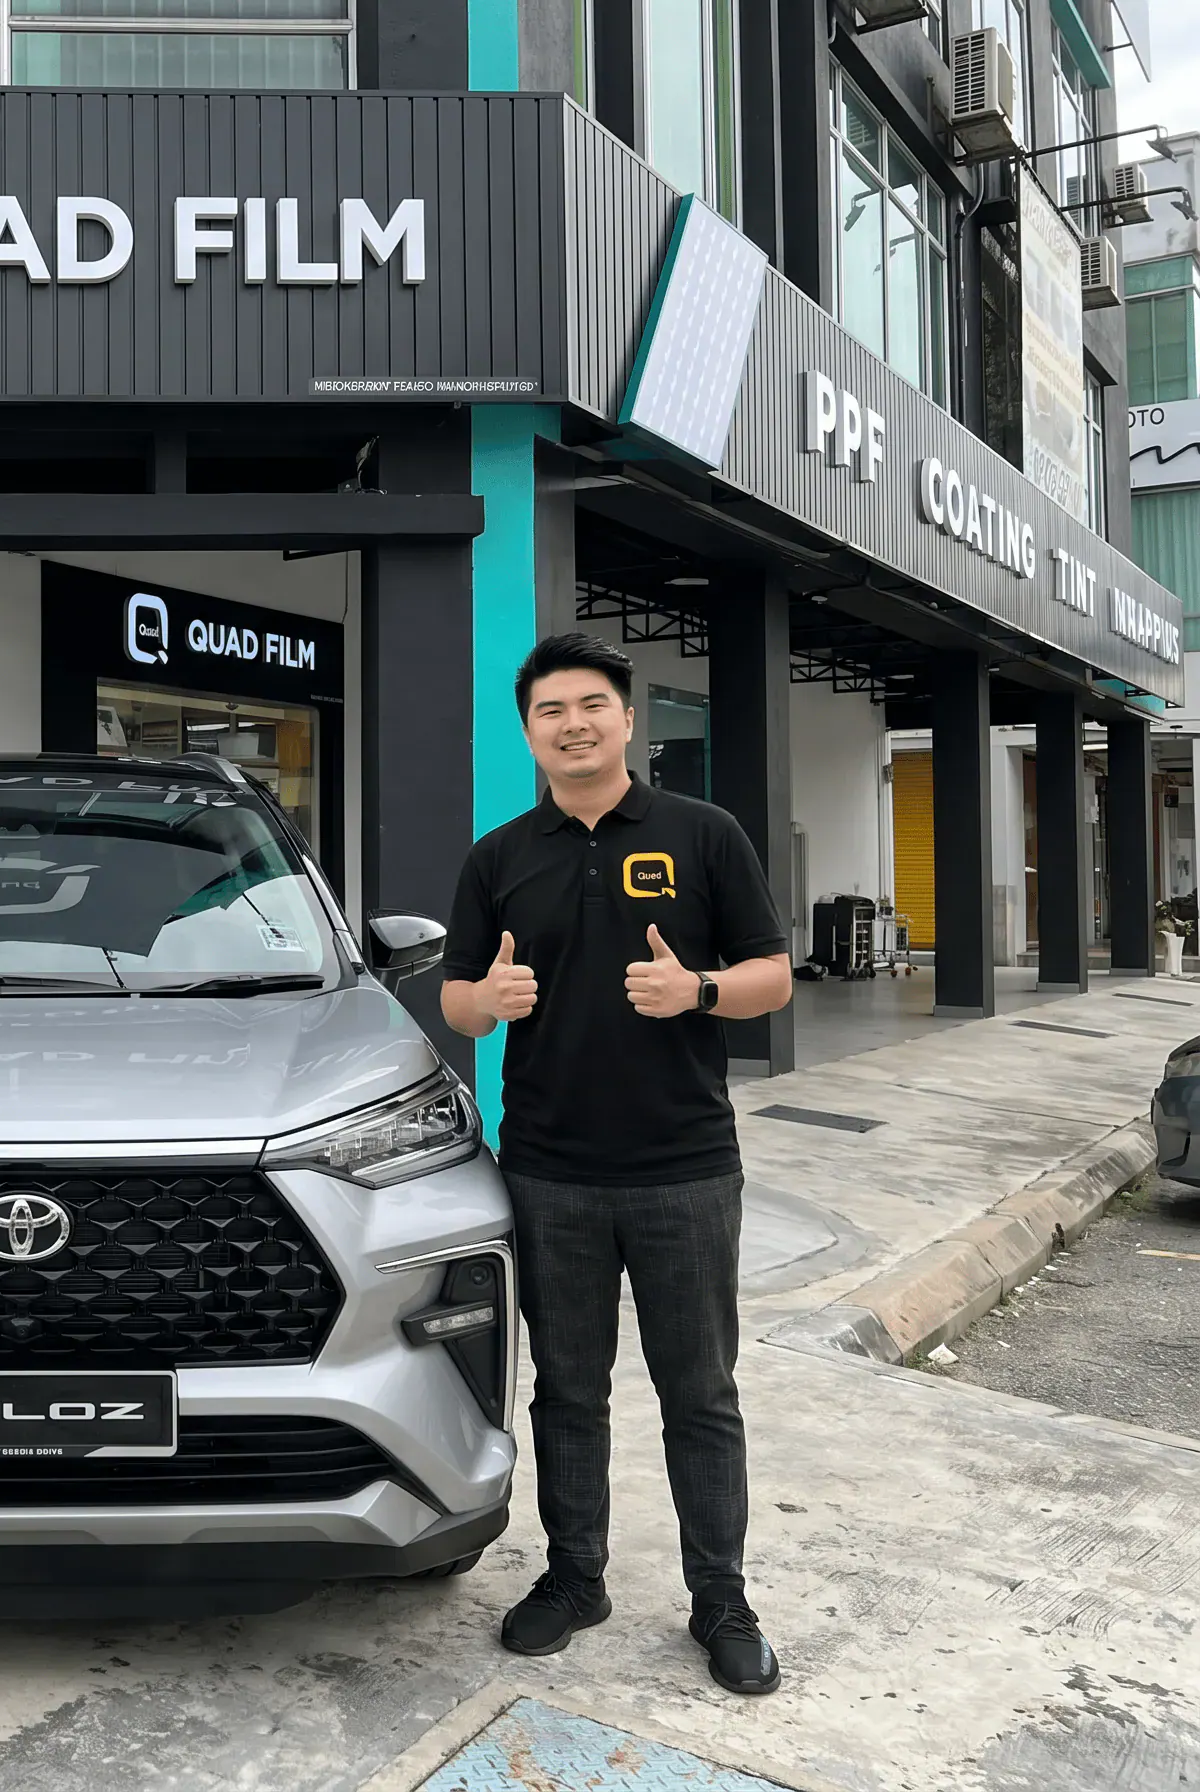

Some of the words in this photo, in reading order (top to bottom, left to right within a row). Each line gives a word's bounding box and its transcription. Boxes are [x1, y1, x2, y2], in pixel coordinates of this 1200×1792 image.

[174, 197, 426, 285] FILM
[807, 370, 886, 484] PPF
[921, 457, 1036, 579] COATING
[1053, 547, 1097, 618] TINT
[187, 618, 259, 661] QUAD
[265, 632, 316, 671] FILM
